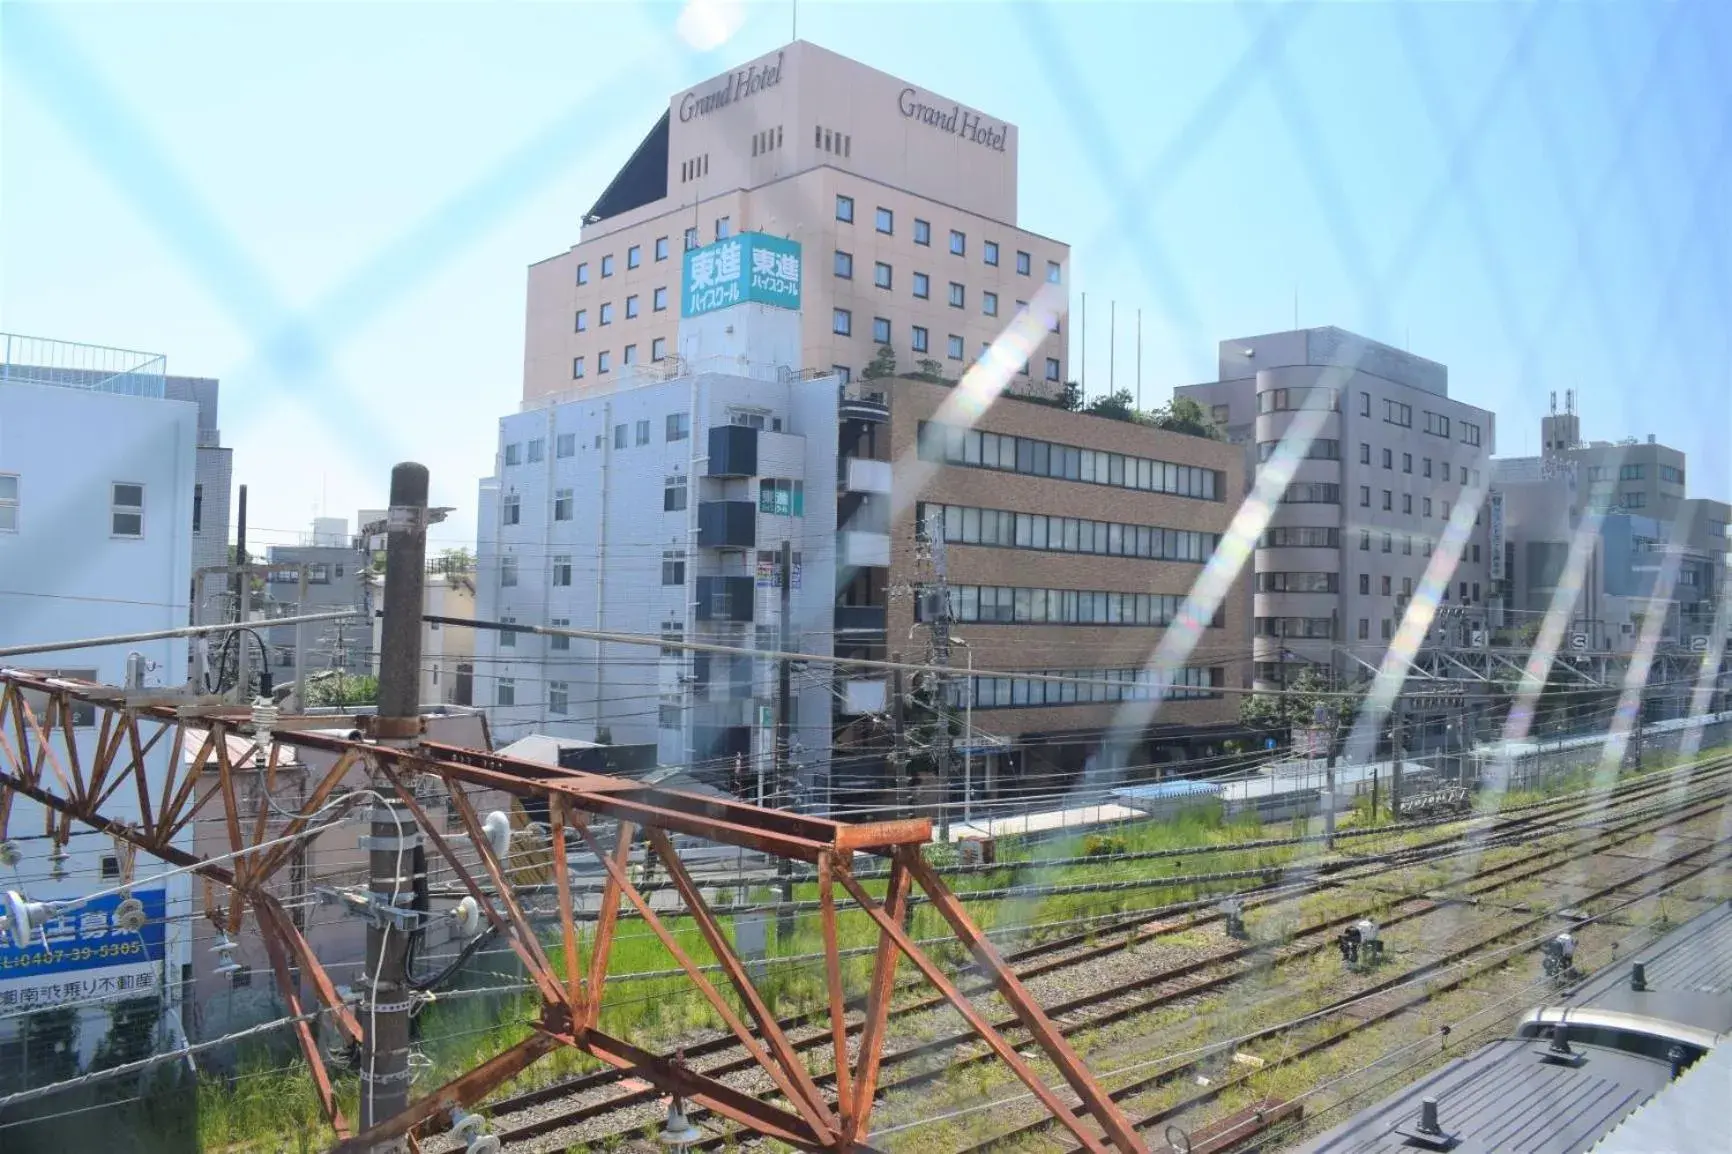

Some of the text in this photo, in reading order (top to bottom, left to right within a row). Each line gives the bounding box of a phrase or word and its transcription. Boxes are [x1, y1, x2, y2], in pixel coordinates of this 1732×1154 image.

[679, 51, 784, 123] Grand Hotel
[898, 87, 1006, 152] Grand Hotel
[690, 241, 741, 291] 東進
[752, 248, 799, 281] 東進
[690, 282, 740, 313] ハイスクール
[752, 275, 799, 296] ハイスクール
